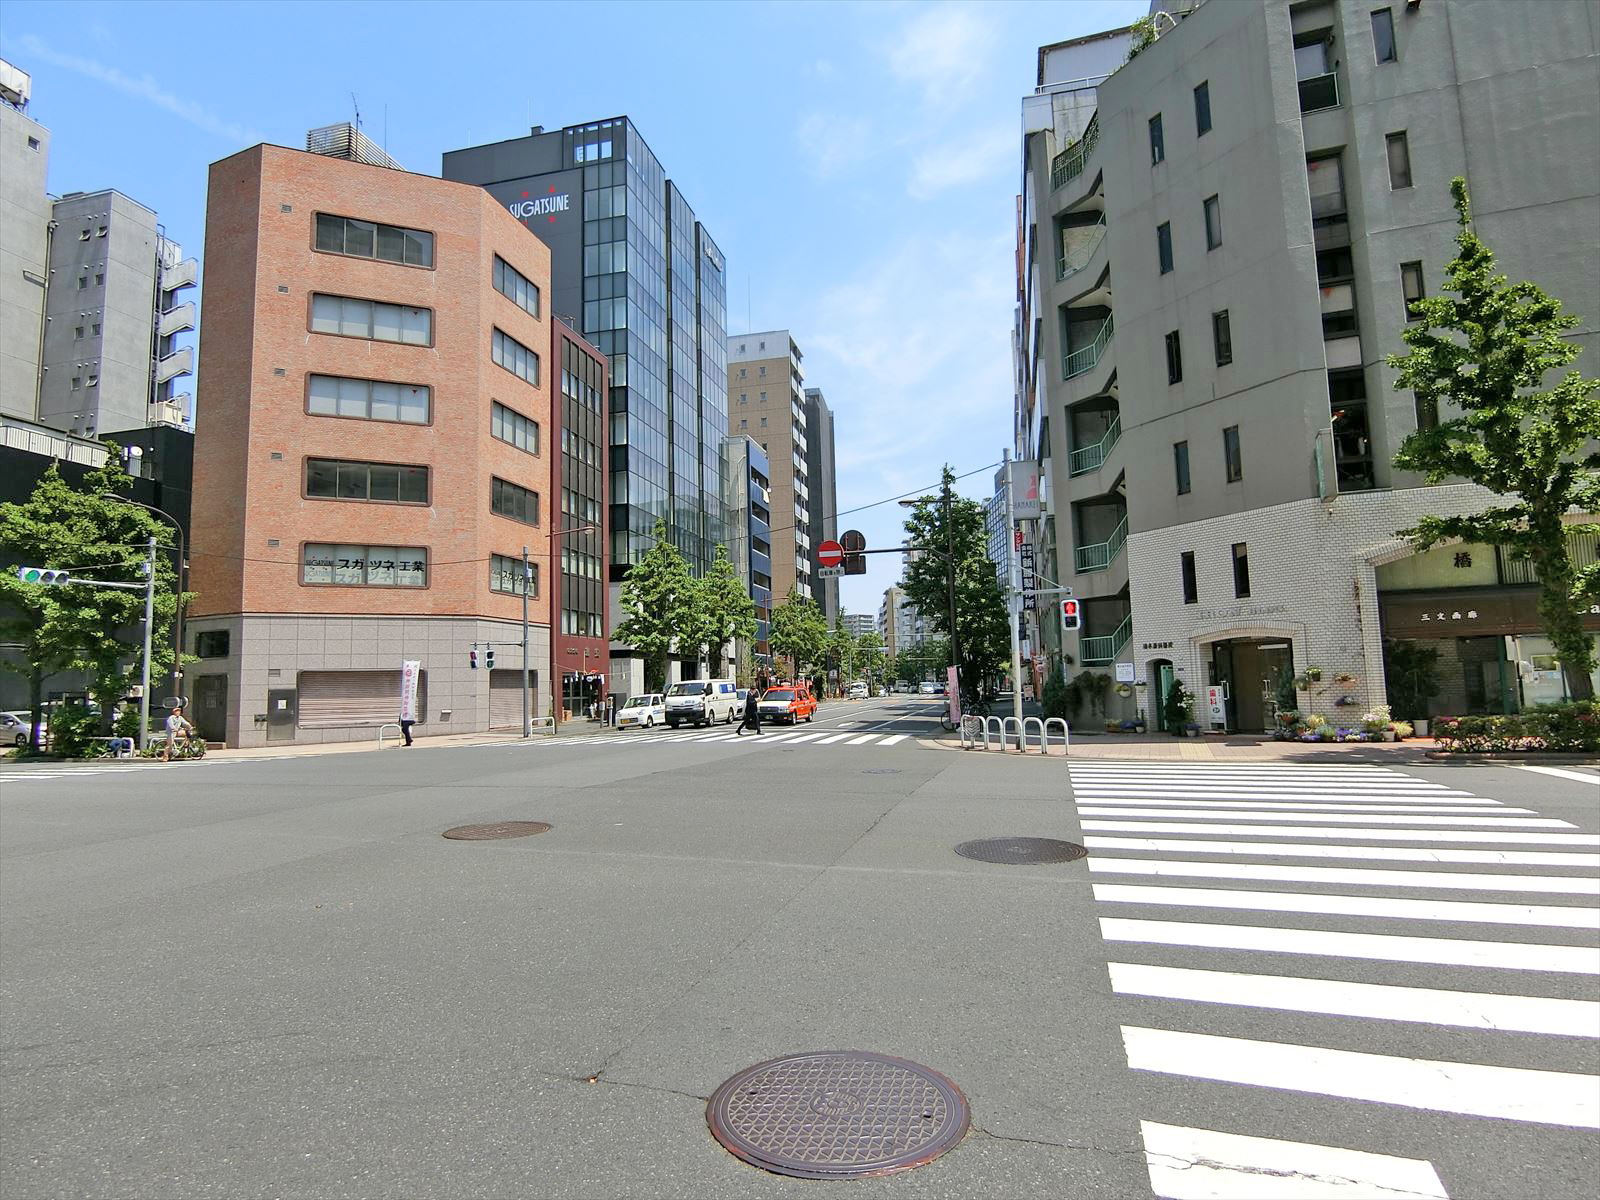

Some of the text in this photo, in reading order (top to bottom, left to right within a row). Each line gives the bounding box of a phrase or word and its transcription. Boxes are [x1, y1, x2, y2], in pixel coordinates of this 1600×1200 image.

[509, 194, 570, 219] SUGATSUNE
[336, 558, 424, 572] スガツネ工業
[1453, 551, 1472, 569] 橋
